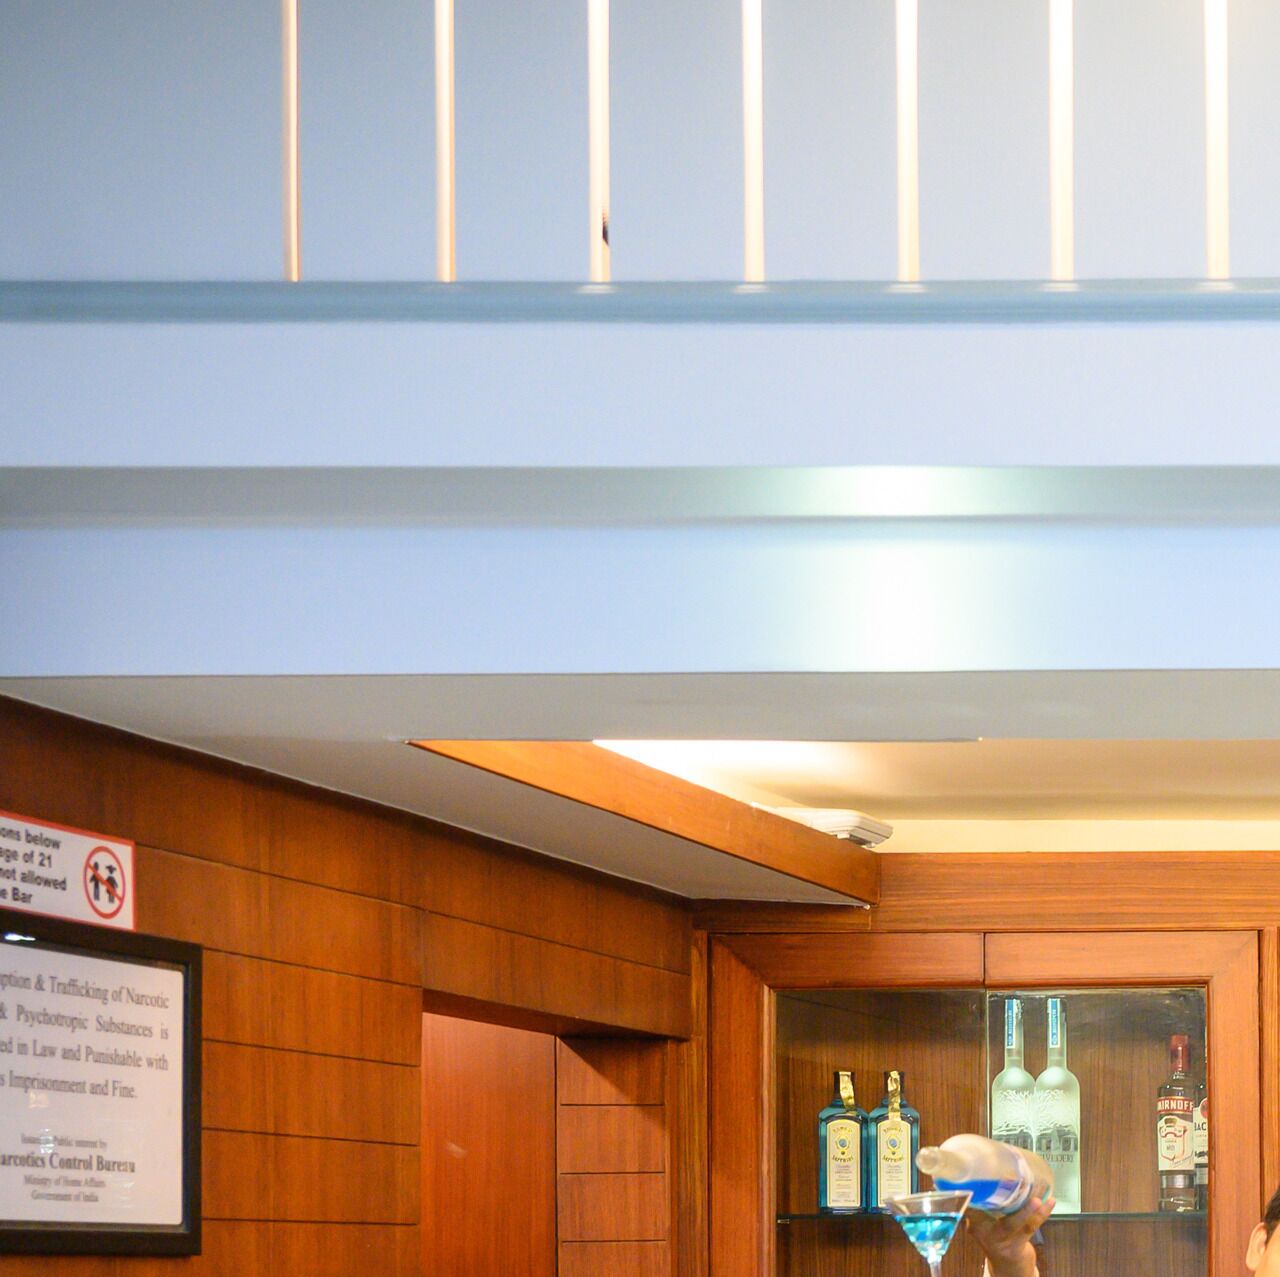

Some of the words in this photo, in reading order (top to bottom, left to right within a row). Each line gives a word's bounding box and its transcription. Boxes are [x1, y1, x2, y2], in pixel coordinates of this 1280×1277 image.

[25, 829, 61, 849] below
[23, 850, 34, 863] of
[38, 852, 52, 868] 21
[20, 870, 67, 891] allowed
[12, 887, 33, 904] Bar
[35, 974, 45, 992] &
[48, 976, 109, 1005] Trafficking
[111, 986, 125, 1002] of
[126, 987, 170, 1009] Narcotic
[16, 1004, 88, 1033] Psychotropic
[95, 1014, 153, 1039] Substances
[160, 1023, 169, 1040] is
[17, 1038, 28, 1056] in
[32, 1039, 58, 1058] Law
[61, 1044, 81, 1061] and
[85, 1046, 144, 1068] Punishable
[146, 1053, 169, 1071] with
[9, 1070, 87, 1094] Imprisonment
[89, 1079, 109, 1096] and
[111, 1080, 138, 1099] Fine.
[49, 1153, 93, 1171] Control
[96, 1155, 136, 1173] Bureau
